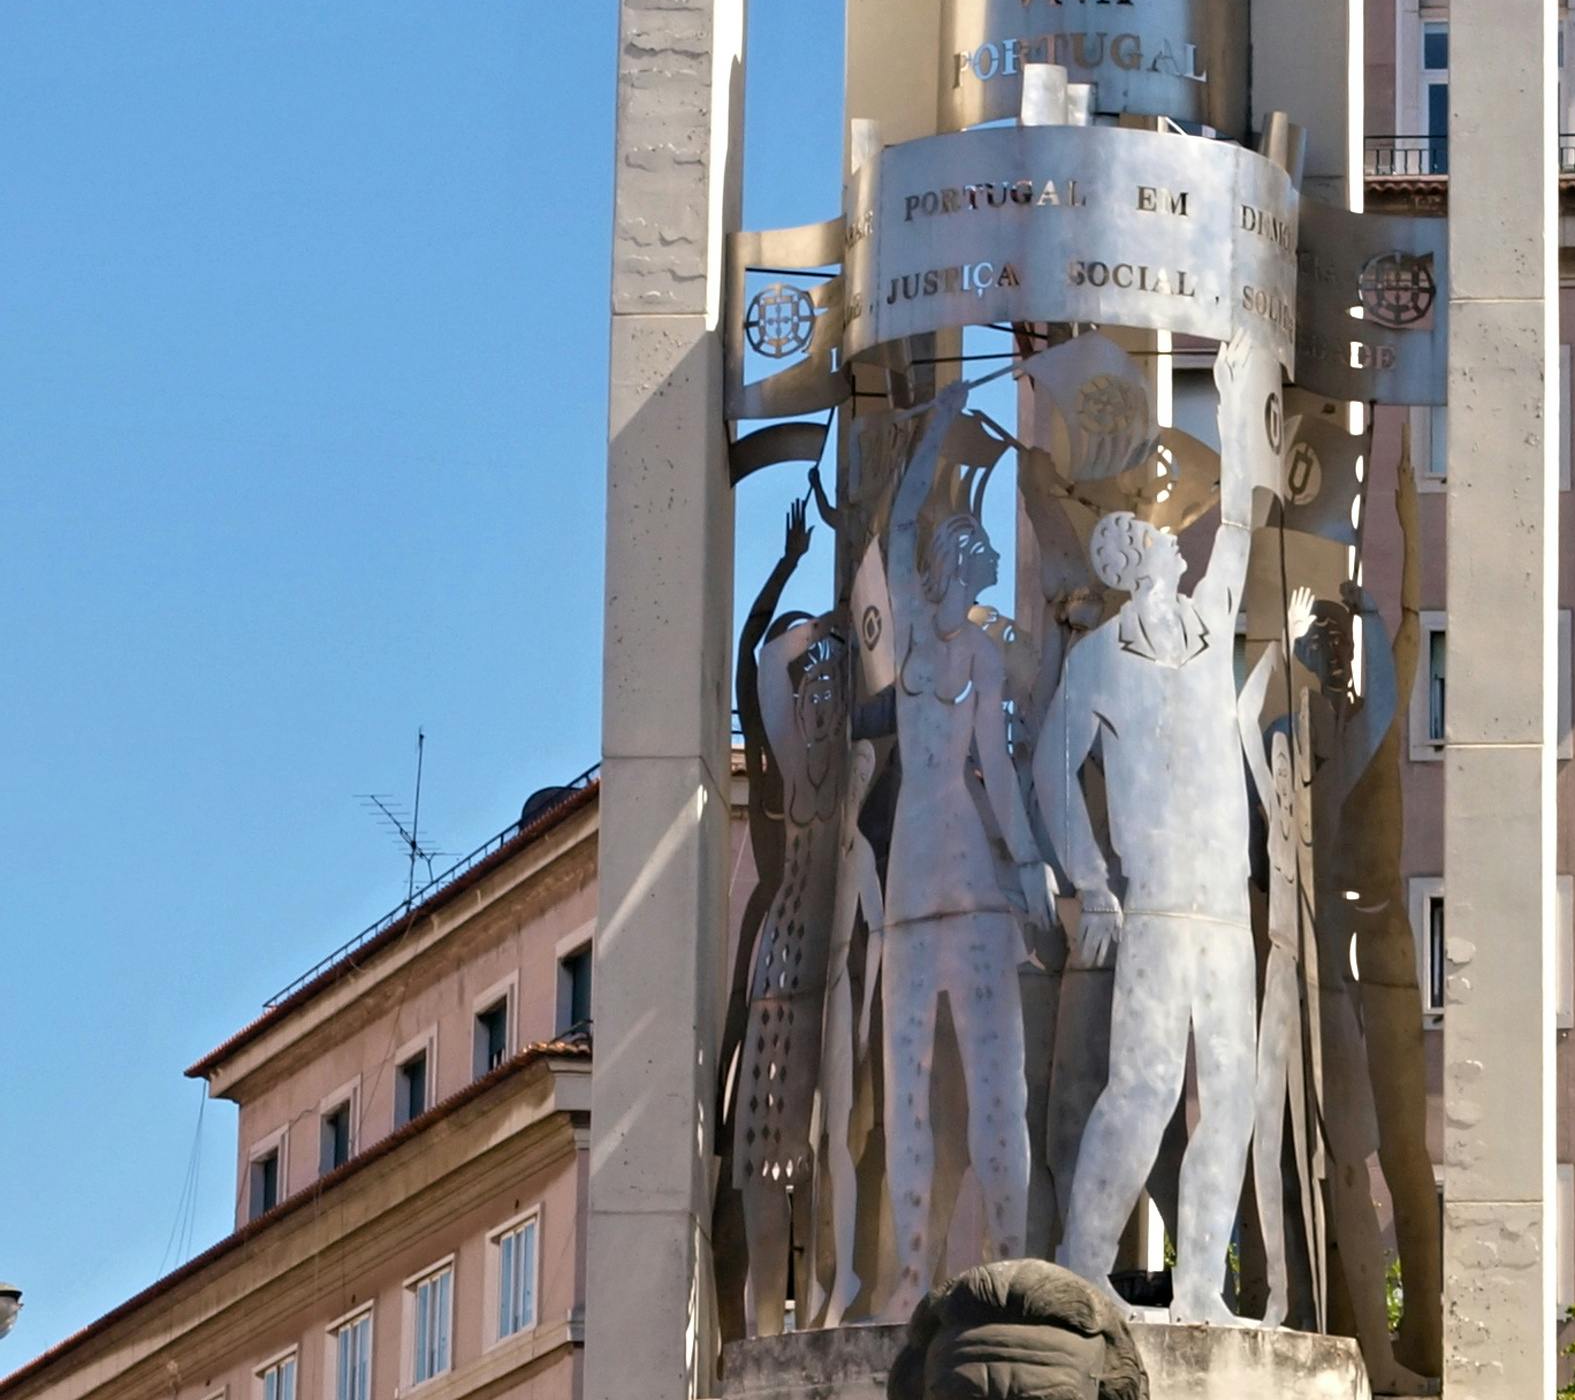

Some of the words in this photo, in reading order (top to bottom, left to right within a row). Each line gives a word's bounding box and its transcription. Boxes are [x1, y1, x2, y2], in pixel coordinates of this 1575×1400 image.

[951, 31, 1208, 90] PORTUGAL
[904, 179, 1087, 222] PORTUGAL
[1135, 185, 1190, 217] EM
[886, 261, 1020, 305] JUSTIÇA
